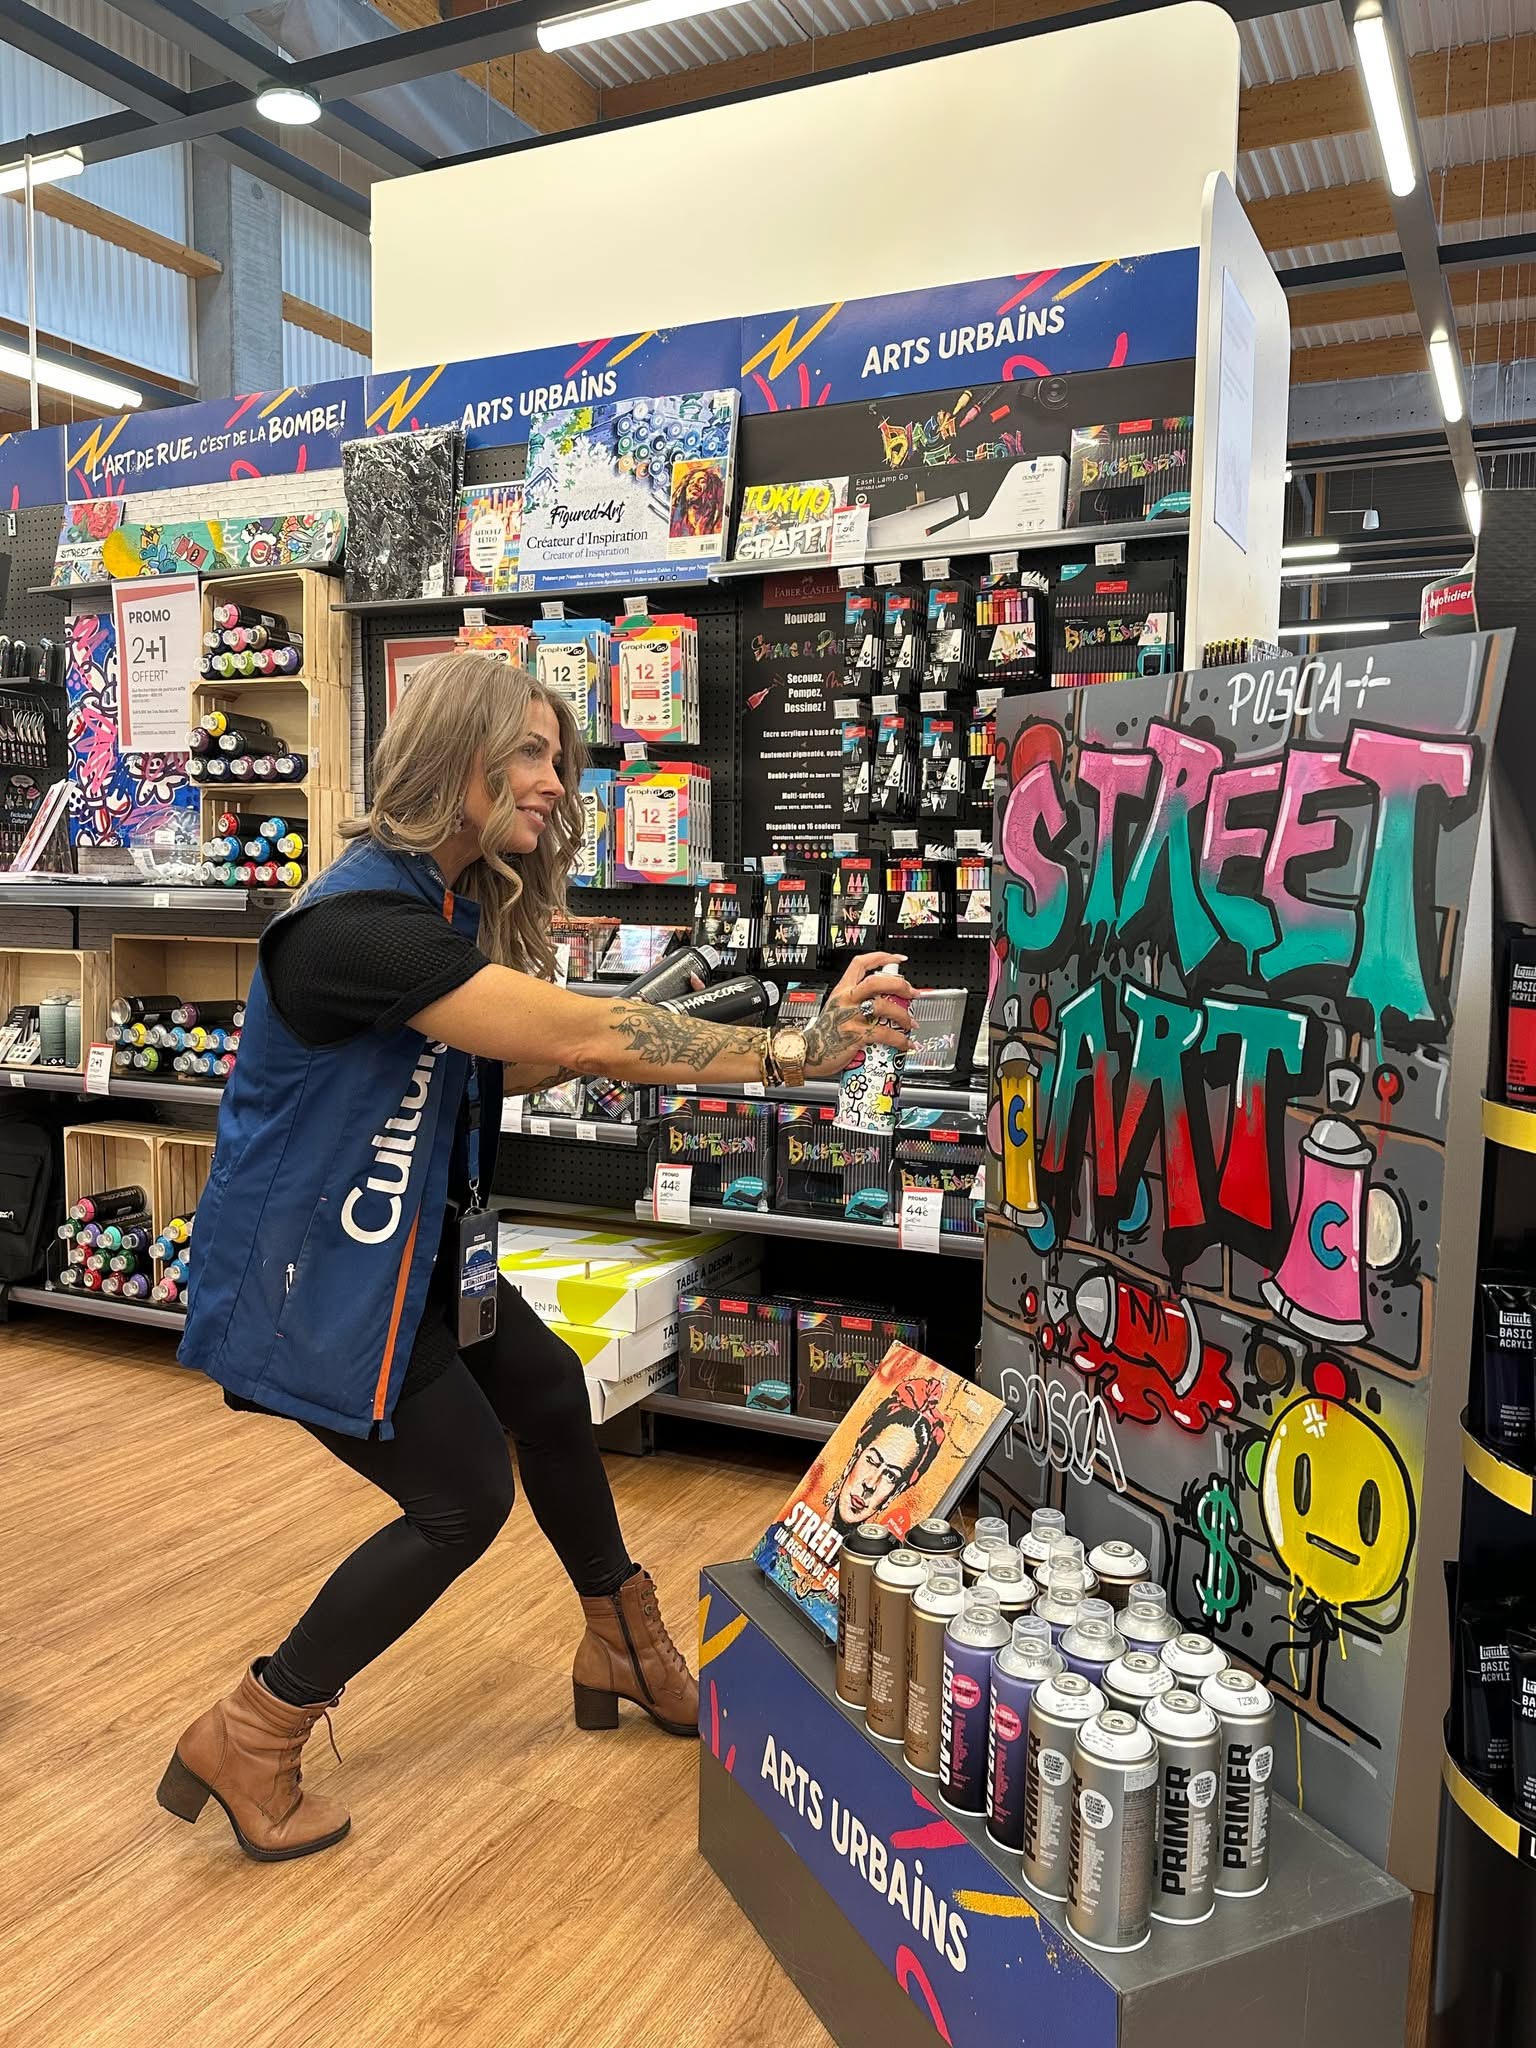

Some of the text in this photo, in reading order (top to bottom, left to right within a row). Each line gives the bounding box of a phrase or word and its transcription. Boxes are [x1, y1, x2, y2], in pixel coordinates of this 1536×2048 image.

[861, 338, 931, 378] ARTS
[461, 397, 514, 431] ARTS
[92, 400, 347, 488] L'ART DE RUE, C'EST DE LA BOMBE!
[856, 473, 909, 487] Easel Lamp Go
[745, 485, 830, 522] TOKYO
[527, 529, 648, 549] Créateur d'Inspiration
[542, 547, 630, 561] Creator of Inspiration
[128, 609, 171, 624] PROMO
[784, 611, 826, 625] Nouveau
[131, 636, 168, 664] 2+1
[552, 665, 572, 682] 12
[635, 663, 655, 680] 12
[787, 672, 824, 684] Secouez,
[788, 687, 823, 699] Pompez,
[784, 701, 821, 714] Dessinez
[780, 729, 809, 739] acrylique
[782, 792, 826, 800] Multi-surfaces
[641, 808, 661, 824] 12
[766, 823, 797, 831] Disponible
[814, 822, 841, 830] couleurs
[1000, 722, 1478, 1025] STREET
[683, 982, 753, 1010] HARDCORE
[1040, 982, 1309, 1232] ART
[676, 1270, 699, 1292] TABLE
[708, 1251, 734, 1273] DESSIN
[534, 1301, 562, 1313] EN PIN
[1000, 1367, 1128, 1494] POSCA
[784, 1500, 845, 1564] STREET
[774, 1526, 828, 1582] UN REGARD DE
[939, 1650, 955, 1787] UV-EFFECT
[760, 1734, 824, 1832] ARTS
[1024, 1729, 1041, 1863] PRIMER
[1223, 1743, 1253, 1869] PRIMER
[1161, 1765, 1191, 1896] PRIMER
